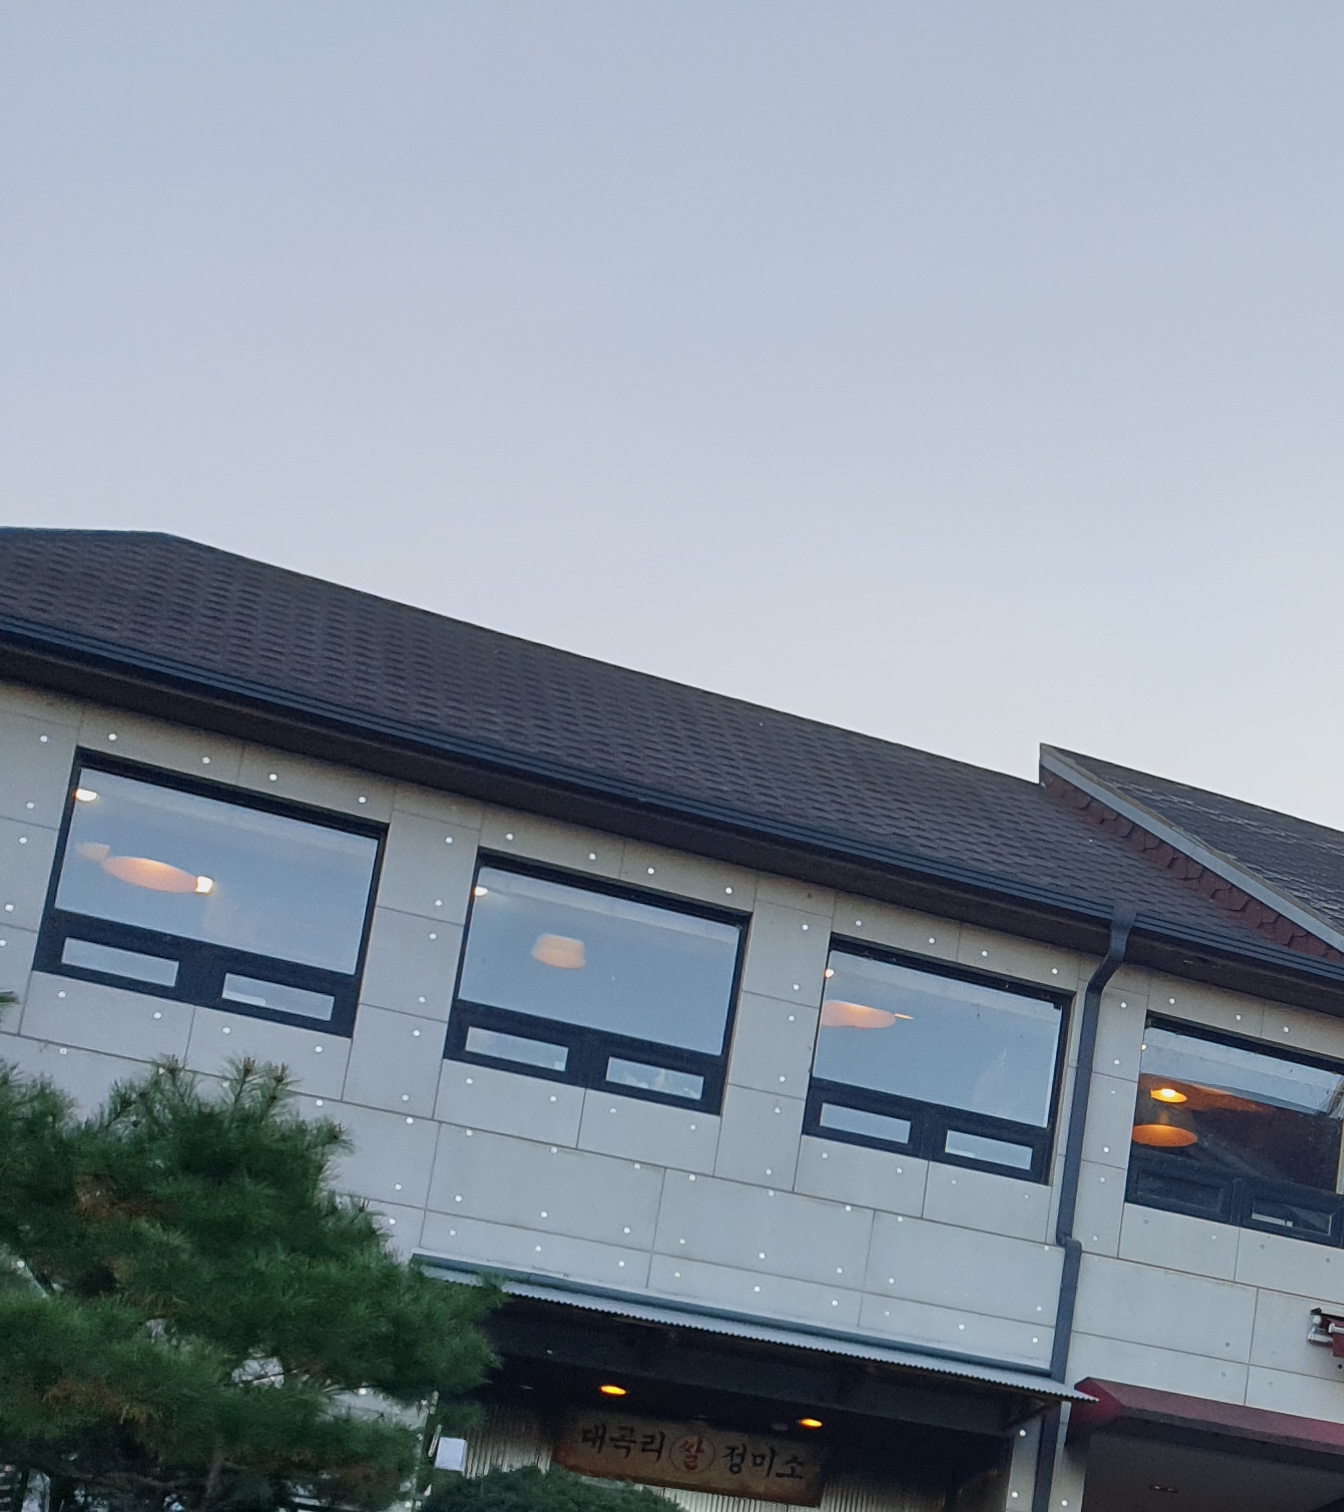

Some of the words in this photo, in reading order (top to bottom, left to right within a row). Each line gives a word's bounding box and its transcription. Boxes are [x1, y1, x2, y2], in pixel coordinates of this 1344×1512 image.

[580, 1422, 667, 1461] 대곡리
[679, 1435, 706, 1471] 쌀
[722, 1442, 805, 1480] 정미소
